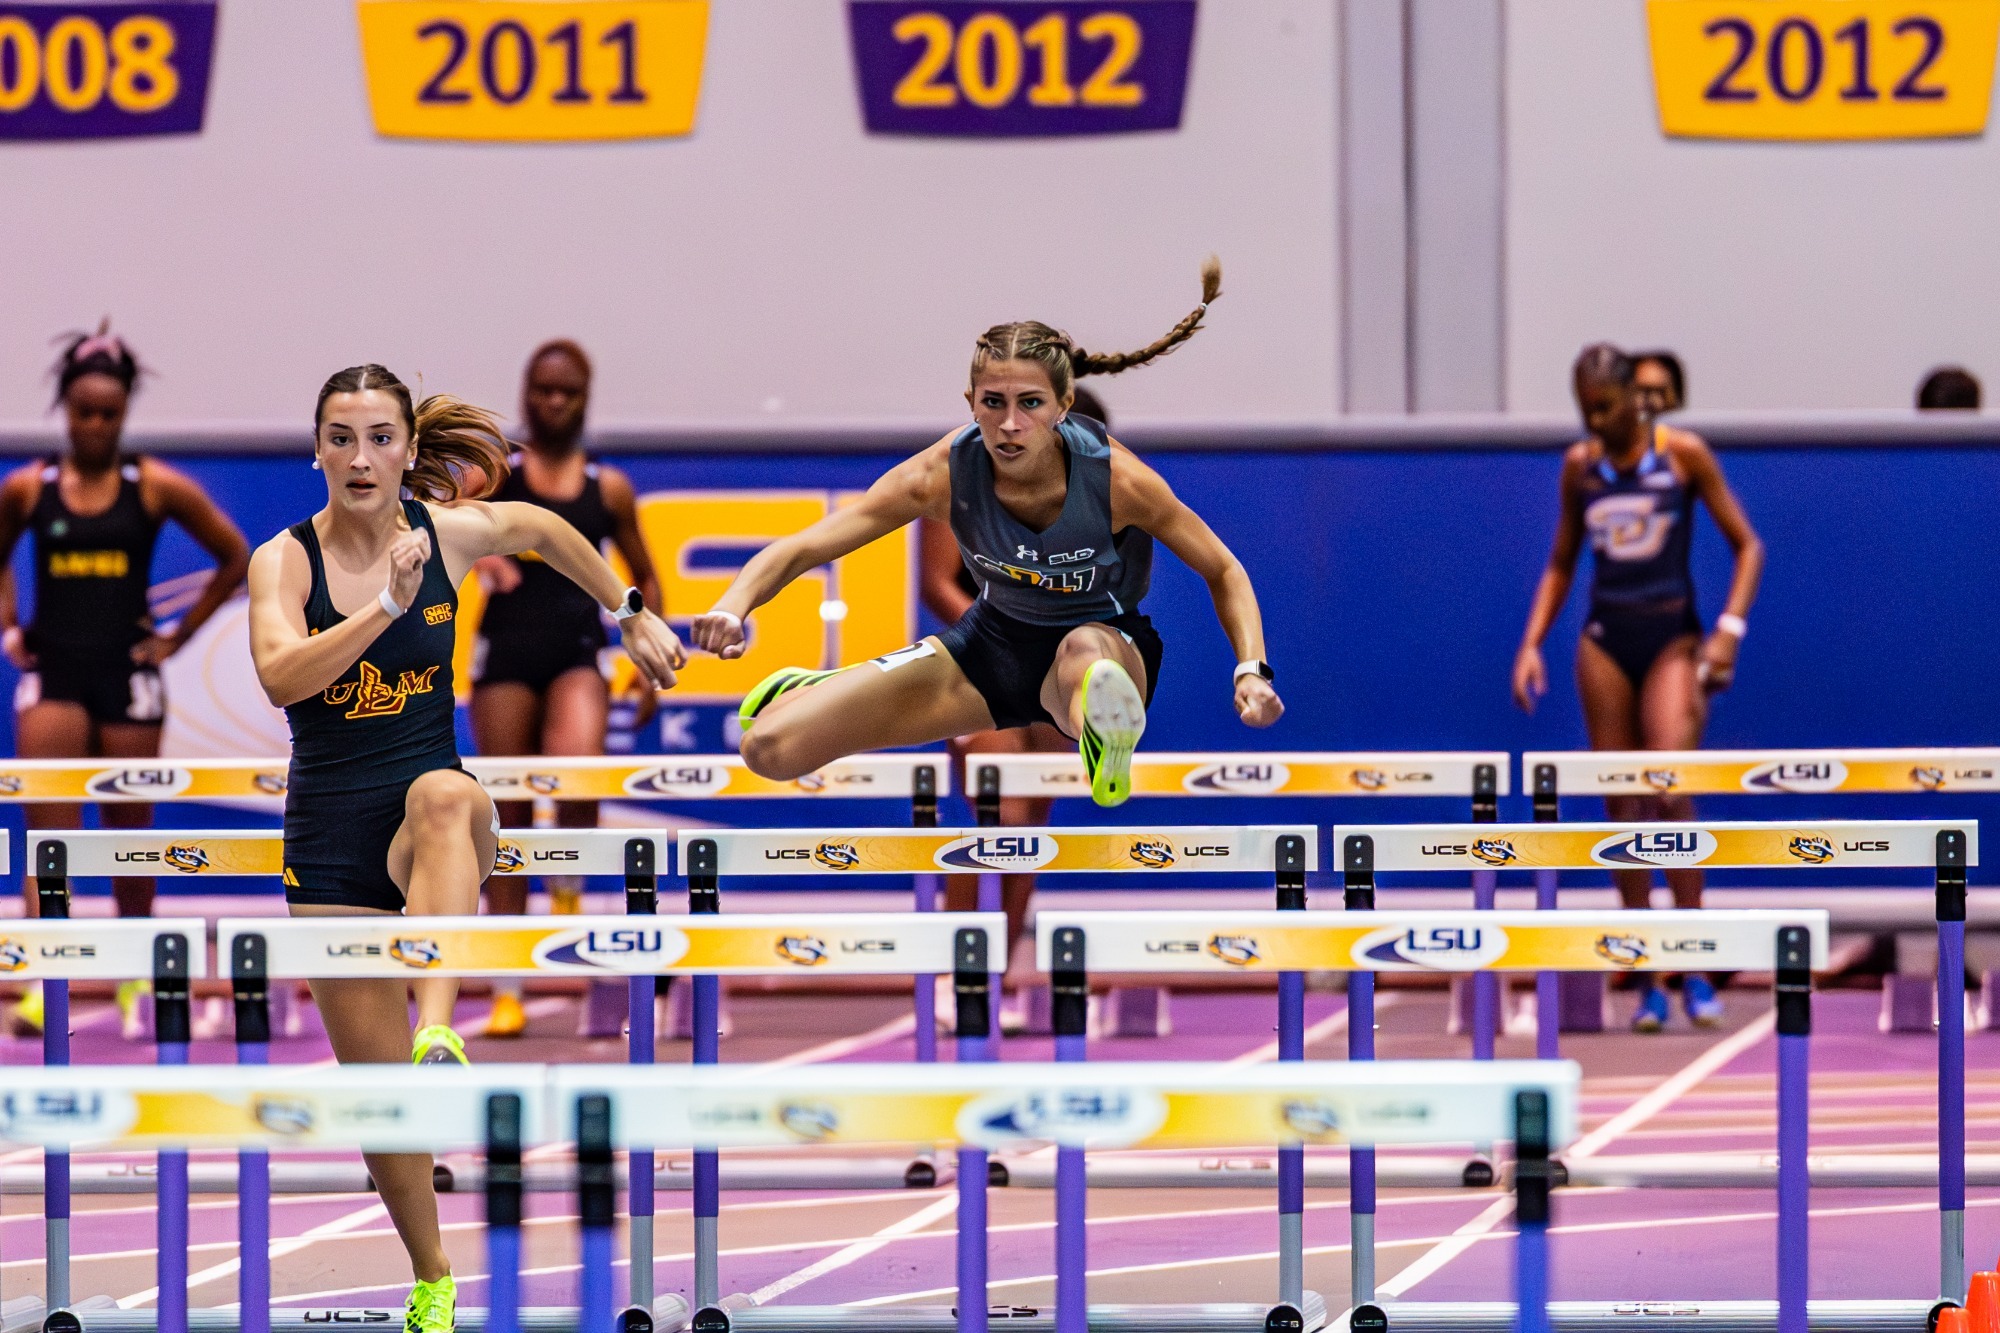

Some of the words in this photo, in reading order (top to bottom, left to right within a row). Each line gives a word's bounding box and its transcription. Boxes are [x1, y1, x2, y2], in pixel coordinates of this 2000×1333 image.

[417, 20, 647, 103] 2011
[893, 13, 1143, 107] 2012
[1703, 17, 1946, 101] 2012
[324, 661, 440, 719] ULM
[123, 769, 174, 785] LSU
[660, 768, 712, 784] LSU
[1220, 765, 1272, 781] LSU
[1779, 764, 1830, 780] LSU
[977, 837, 1039, 857] LSU
[1634, 832, 1698, 852] LSU
[1843, 841, 1890, 852] UCS
[533, 850, 580, 861] UCS
[765, 849, 811, 860] UCS
[1183, 846, 1230, 857] UCS
[1421, 844, 1468, 855] UCS
[115, 851, 160, 863] UCS
[588, 930, 662, 952] LSU
[840, 939, 896, 952] UCS
[1406, 928, 1482, 950] LSU
[1661, 940, 1718, 952] UCS
[41, 945, 96, 957] UCS
[326, 944, 381, 956] UCS
[1145, 941, 1200, 953] UCS
[303, 1310, 392, 1322] UCS
